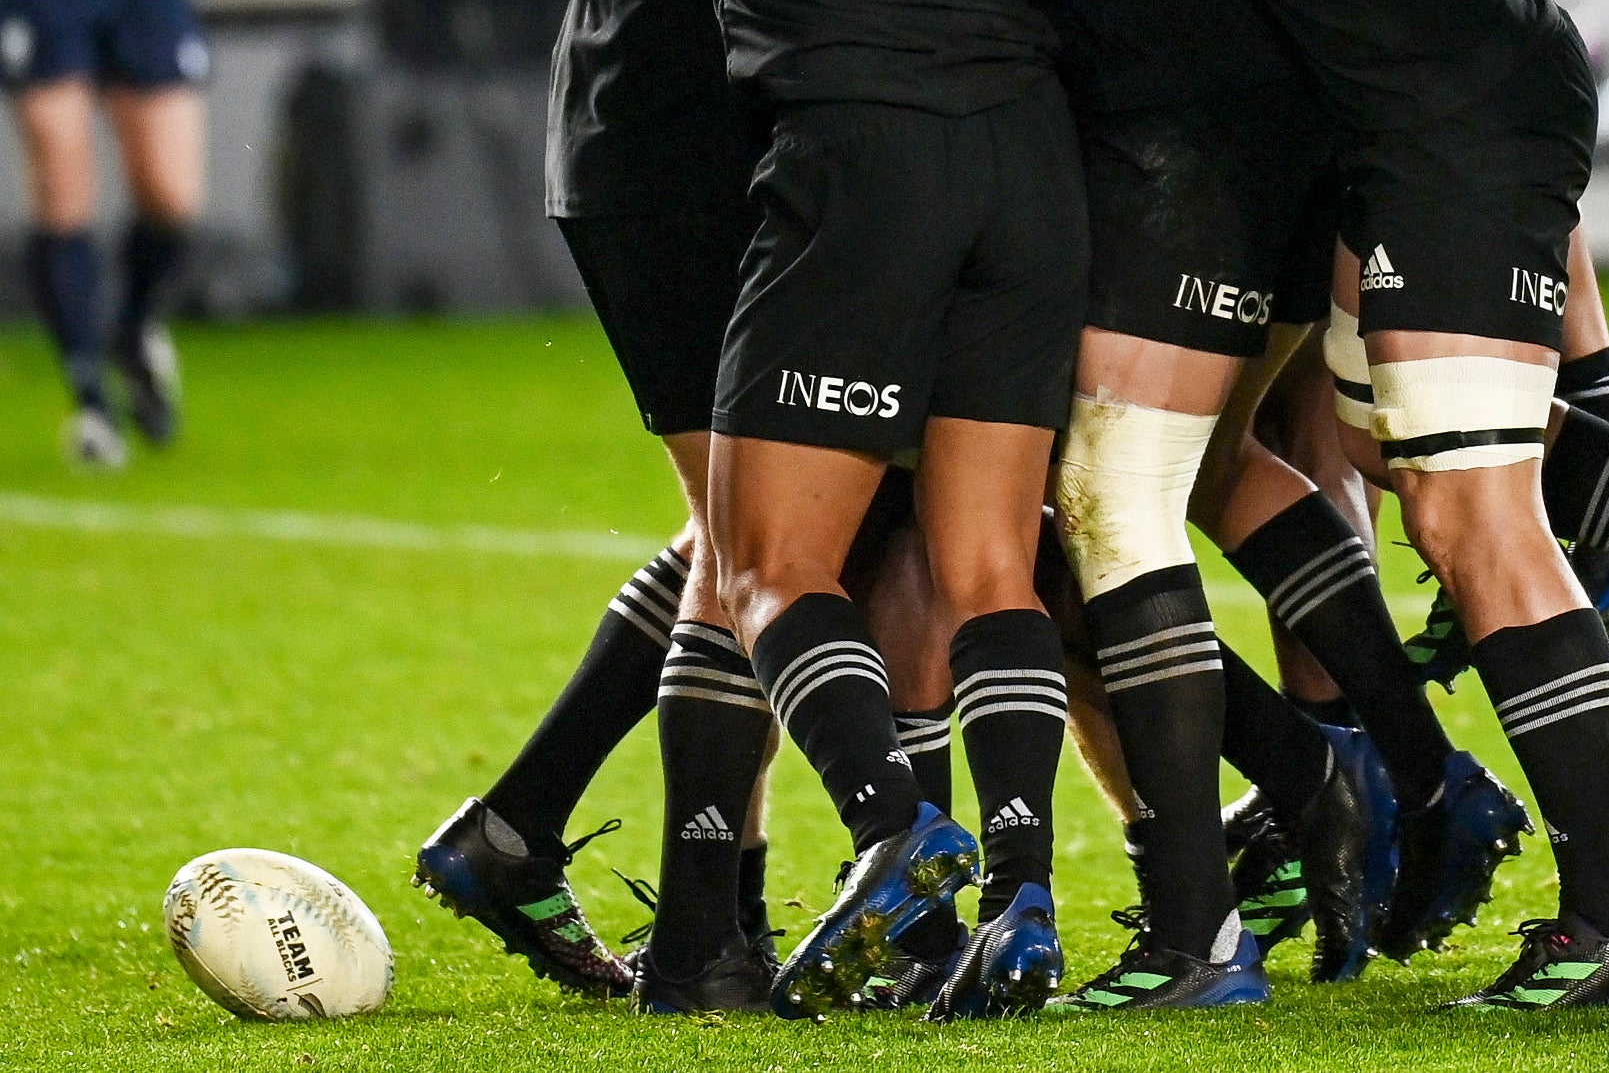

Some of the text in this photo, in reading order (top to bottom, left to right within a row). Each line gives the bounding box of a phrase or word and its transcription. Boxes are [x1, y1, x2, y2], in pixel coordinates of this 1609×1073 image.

[1172, 273, 1272, 325] INEOS
[1509, 267, 1568, 316] INEO
[776, 369, 902, 418] INEOS
[680, 828, 734, 841] adidas
[988, 813, 1040, 834] adidas
[267, 919, 297, 983] ALL BLACKS
[278, 910, 315, 979] TEAM
